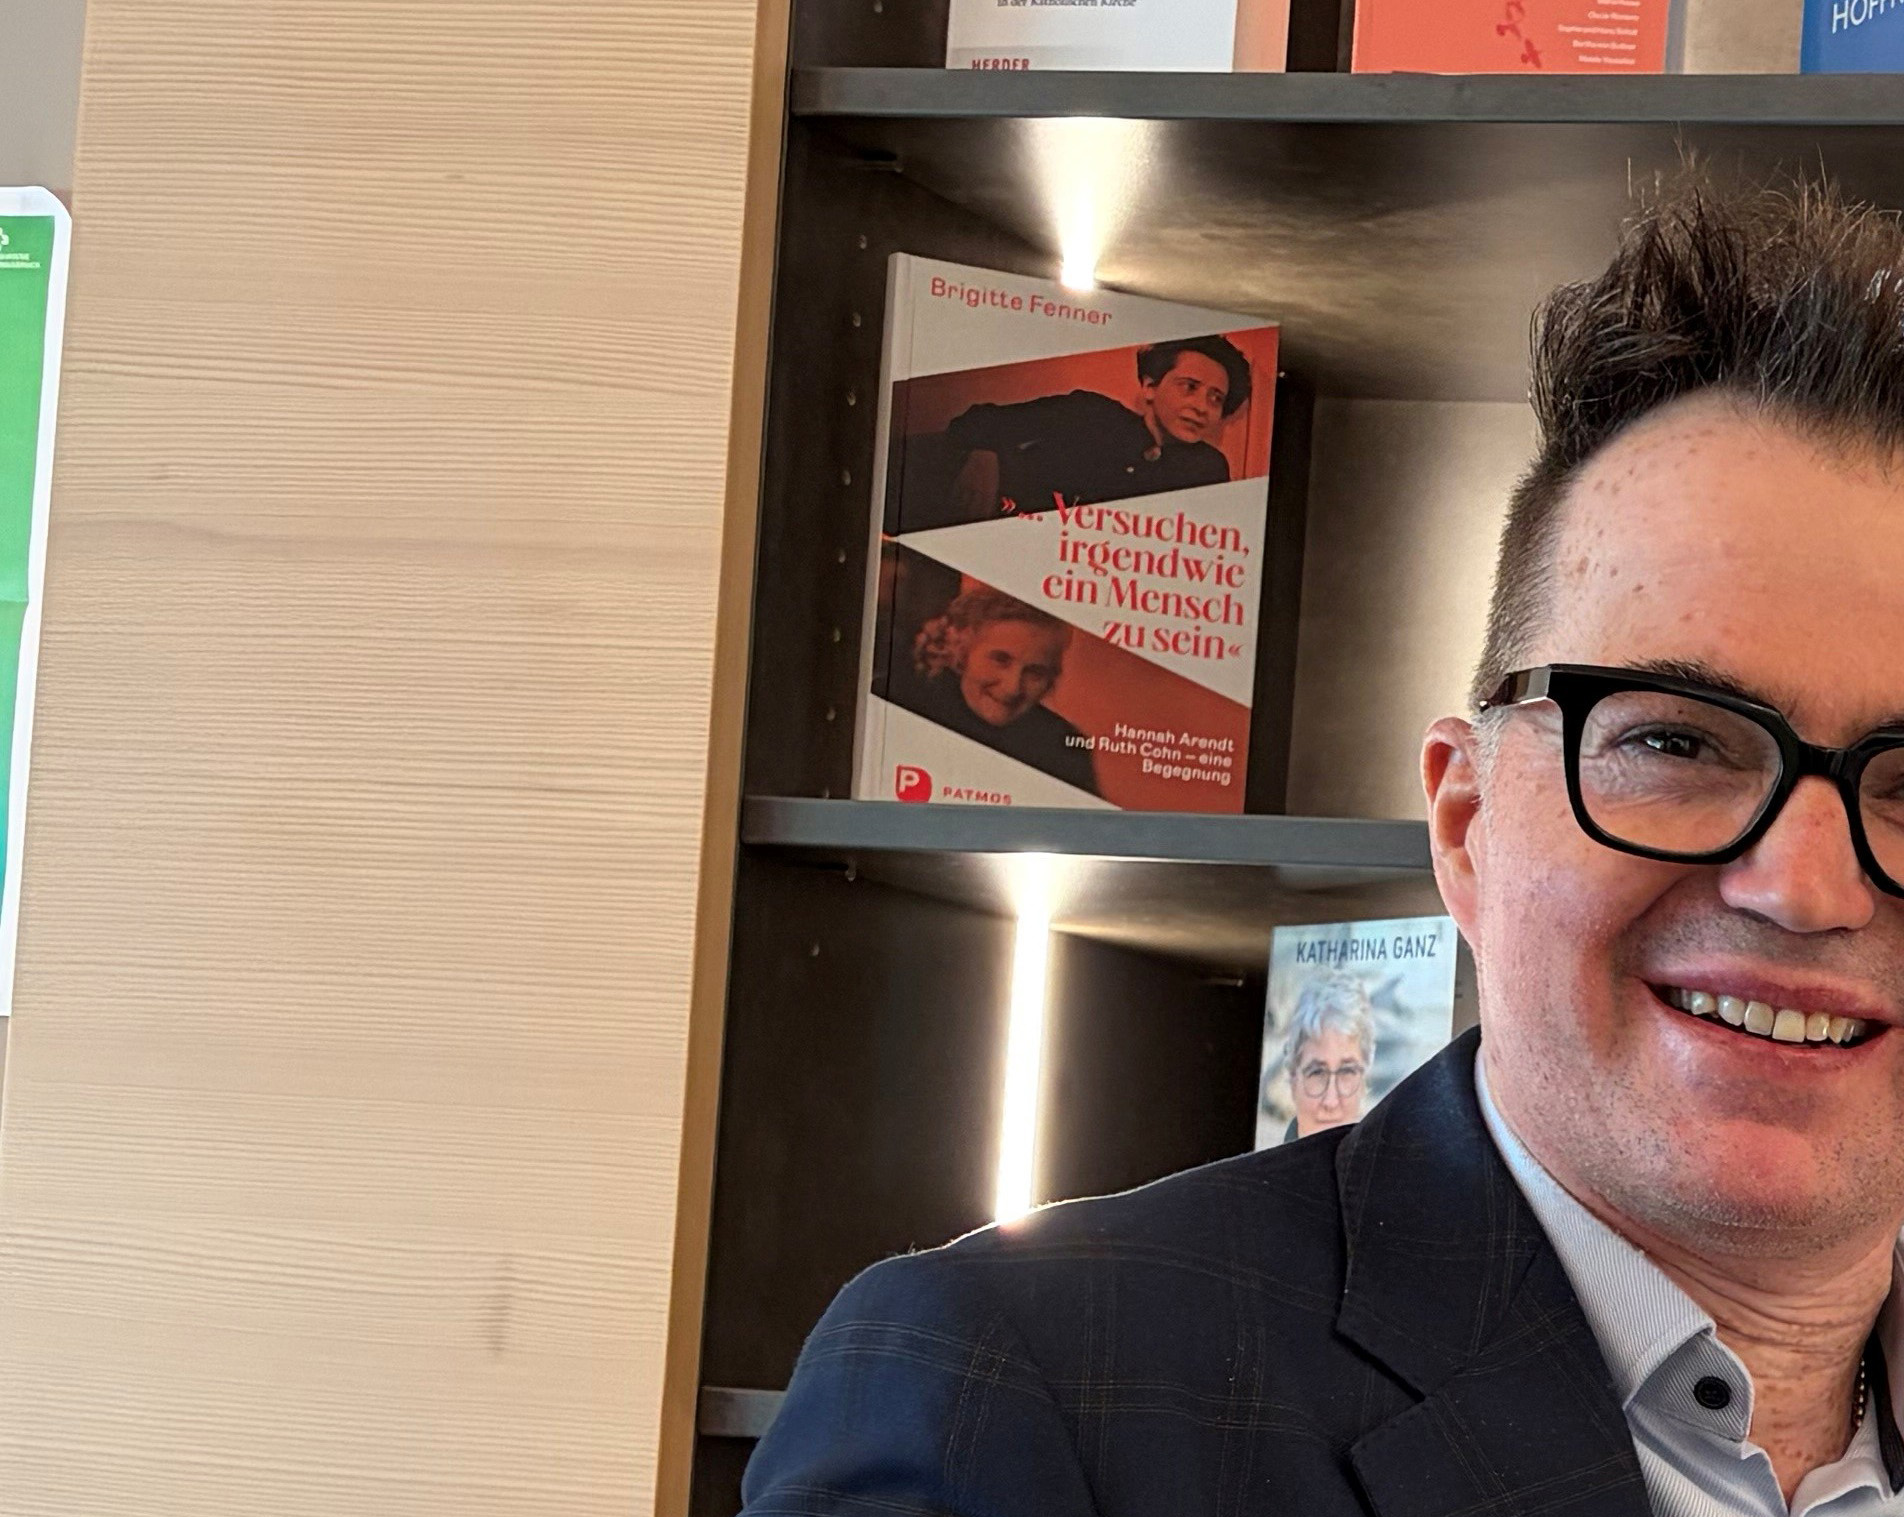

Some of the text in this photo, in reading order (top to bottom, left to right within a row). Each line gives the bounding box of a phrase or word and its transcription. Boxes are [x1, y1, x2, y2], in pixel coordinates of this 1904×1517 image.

[930, 276, 1112, 327] Brigitte Fenner
[1052, 490, 1251, 558] Versuchen,
[1058, 530, 1246, 589] irgendwie
[1042, 570, 1246, 627] ein Mensch
[1103, 620, 1145, 650] zu
[1065, 733, 1233, 768] und Ruth Cohn eine
[1114, 723, 1235, 753] Hannah Arendt
[1142, 759, 1232, 787] Begegnung
[943, 786, 1012, 806] PATMOS
[1296, 934, 1437, 964] KATHARINA GANZ
